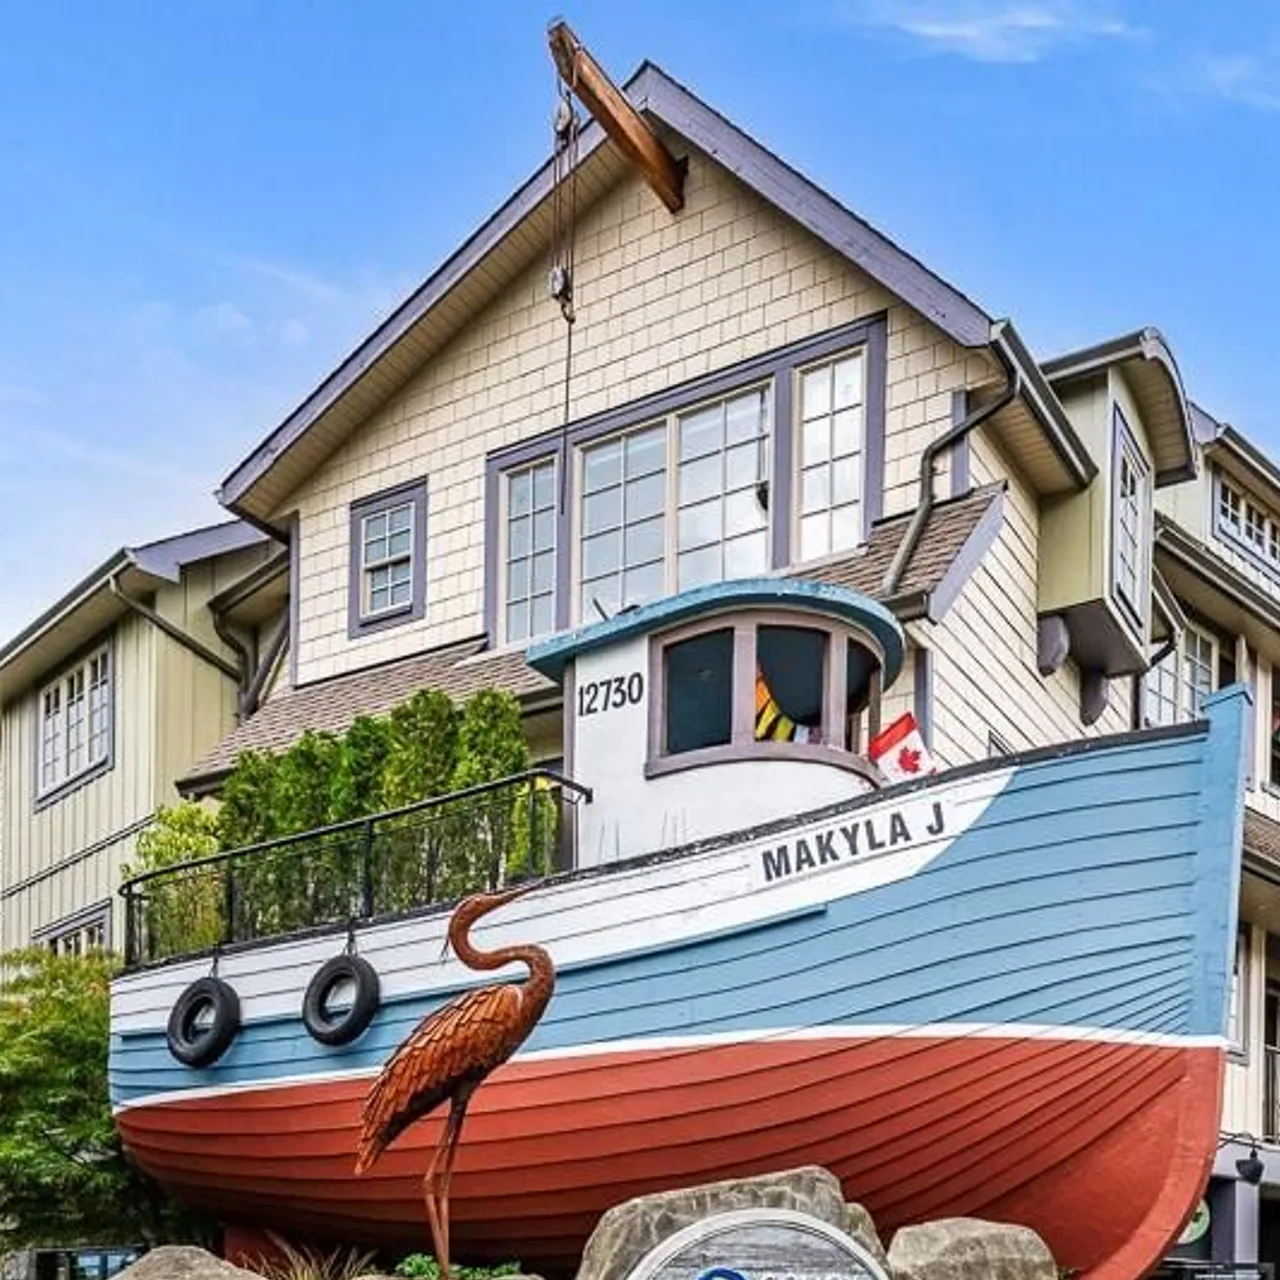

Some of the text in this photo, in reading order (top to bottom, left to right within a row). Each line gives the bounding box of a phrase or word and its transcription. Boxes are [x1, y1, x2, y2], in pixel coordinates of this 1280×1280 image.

[578, 671, 644, 717] 12730
[762, 802, 946, 882] MAKYLA J
